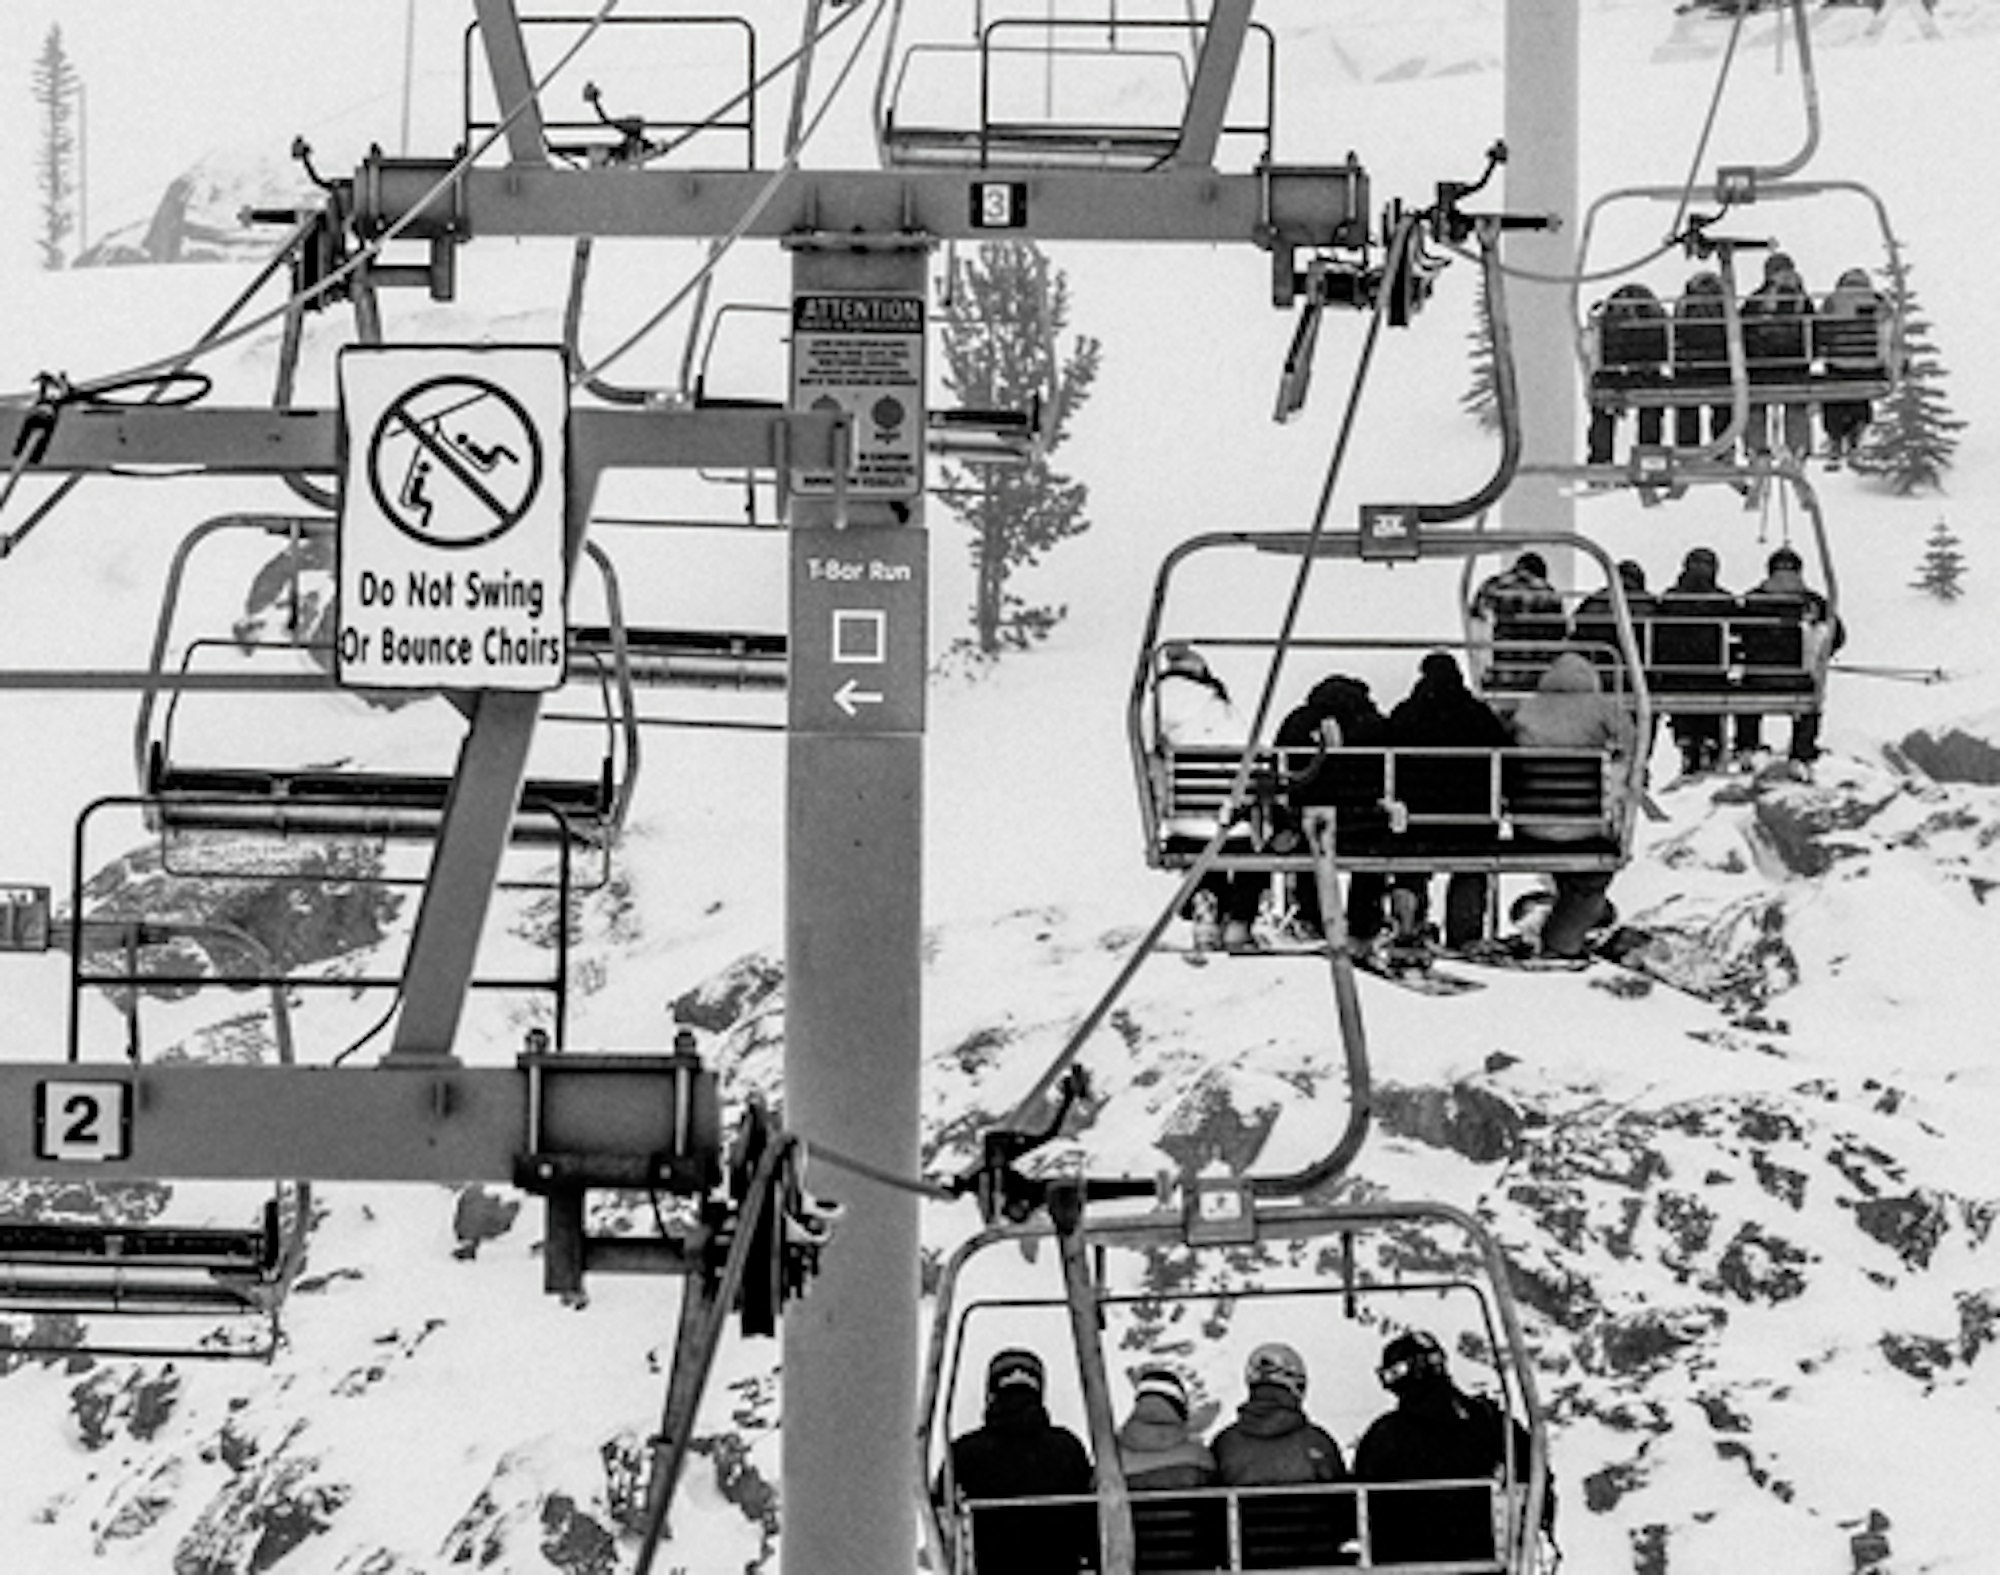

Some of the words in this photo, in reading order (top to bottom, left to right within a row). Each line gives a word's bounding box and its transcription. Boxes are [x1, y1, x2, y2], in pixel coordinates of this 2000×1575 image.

[986, 188, 1005, 218] 3
[803, 299, 920, 320] ATTENTION
[807, 557, 864, 581] T-Bar
[869, 560, 911, 581] Run
[361, 571, 395, 606] Do
[408, 571, 454, 606] Not
[465, 569, 544, 619] Swing
[341, 627, 370, 664] Or
[382, 627, 473, 665] Bounce
[483, 626, 560, 666] Chairs
[63, 1094, 100, 1144] 2
